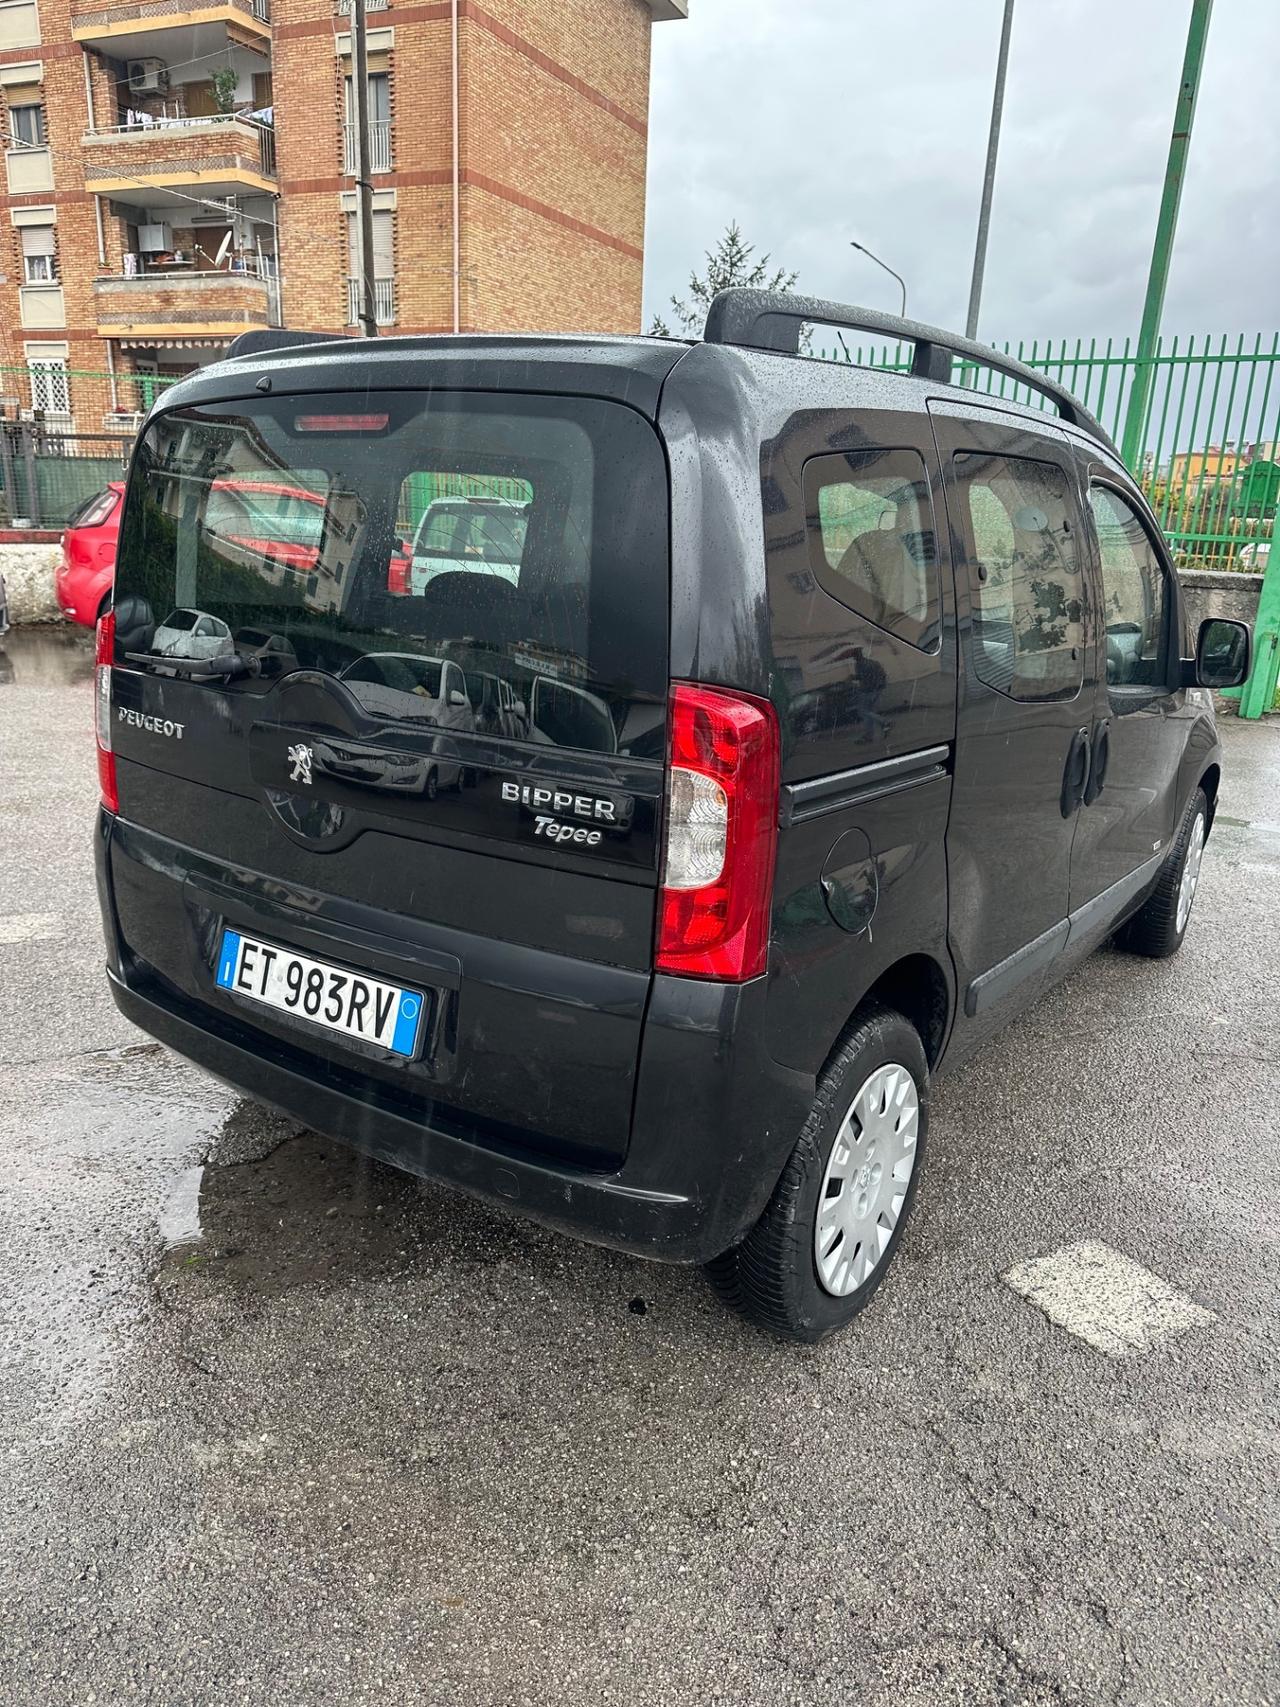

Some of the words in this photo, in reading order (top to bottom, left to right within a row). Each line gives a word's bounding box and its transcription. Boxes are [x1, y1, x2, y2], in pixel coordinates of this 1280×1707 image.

[119, 706, 185, 739] PEUGEOT
[501, 782, 615, 821] BIPPER
[534, 815, 602, 845] Tepee
[237, 942, 277, 996] ET
[284, 960, 395, 1039] 983RV
